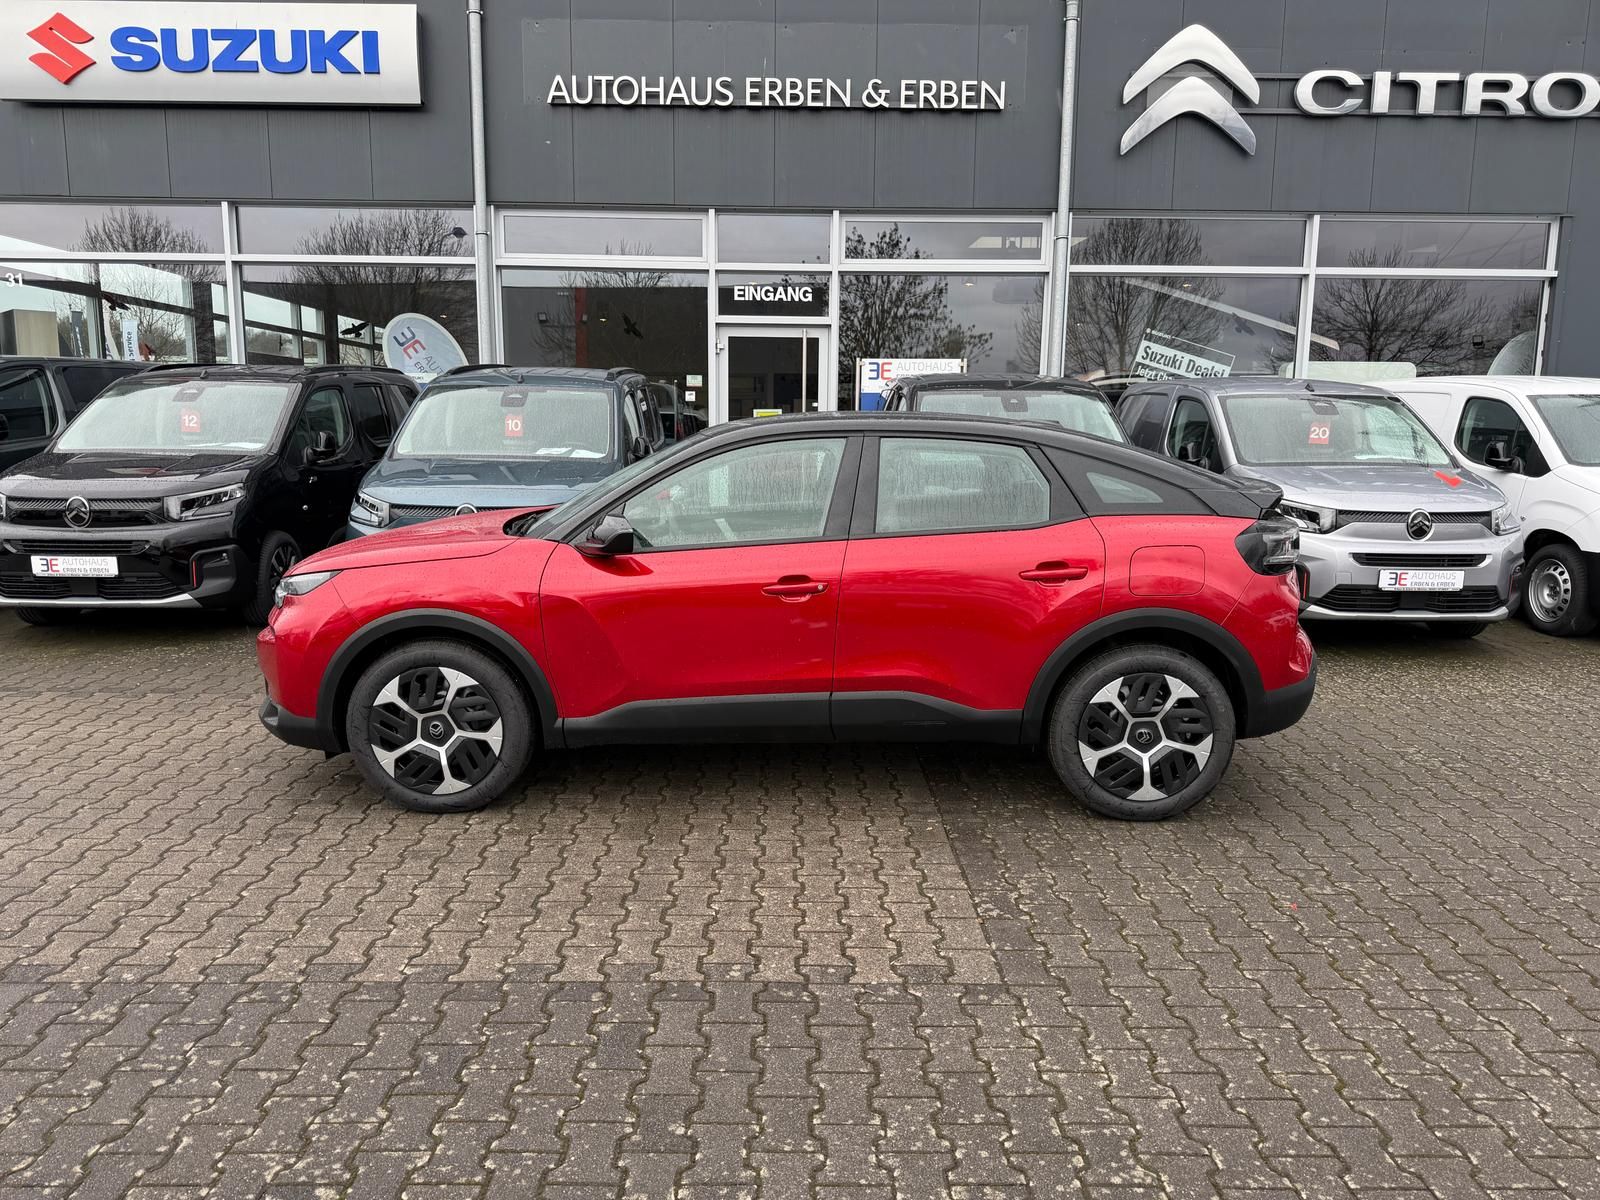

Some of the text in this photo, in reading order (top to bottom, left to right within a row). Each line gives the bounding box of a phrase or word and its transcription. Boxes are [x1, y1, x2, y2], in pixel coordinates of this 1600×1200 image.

[110, 27, 380, 74] SUZUKI
[547, 75, 1006, 110] AUTOHAUS ERBEN & ERBEN
[1294, 70, 1600, 118] CITRO
[5, 273, 24, 287] 31
[734, 285, 812, 302] EINGANG
[1141, 345, 1184, 370] Suzuki
[897, 361, 953, 372] AUTOHAUS
[183, 414, 197, 427] 12
[506, 419, 521, 431] 10
[1310, 426, 1329, 439] 20
